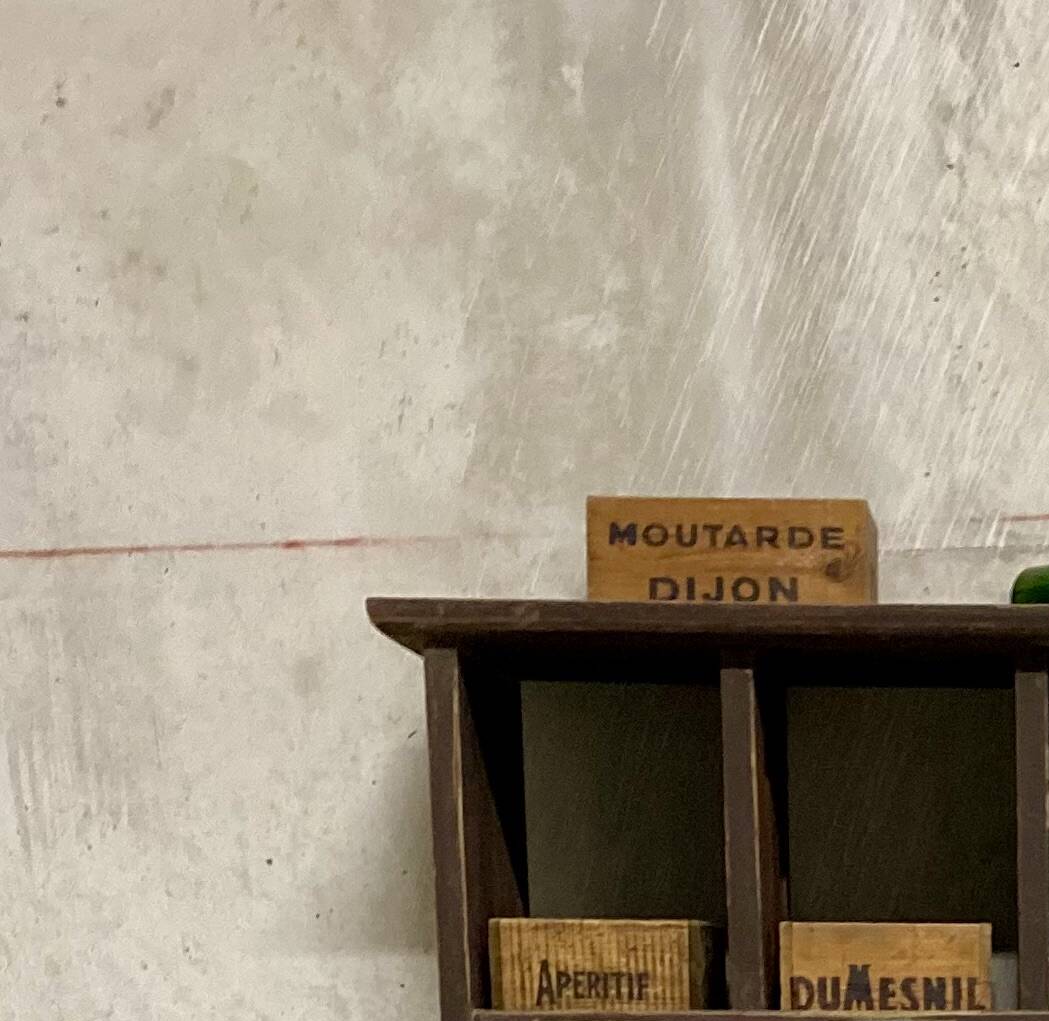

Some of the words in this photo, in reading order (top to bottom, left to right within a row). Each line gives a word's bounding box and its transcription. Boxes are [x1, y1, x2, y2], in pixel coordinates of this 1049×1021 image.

[608, 521, 845, 550] MOUTARDE
[649, 576, 799, 602] DIJON
[790, 964, 986, 1010] DUMESNIL
